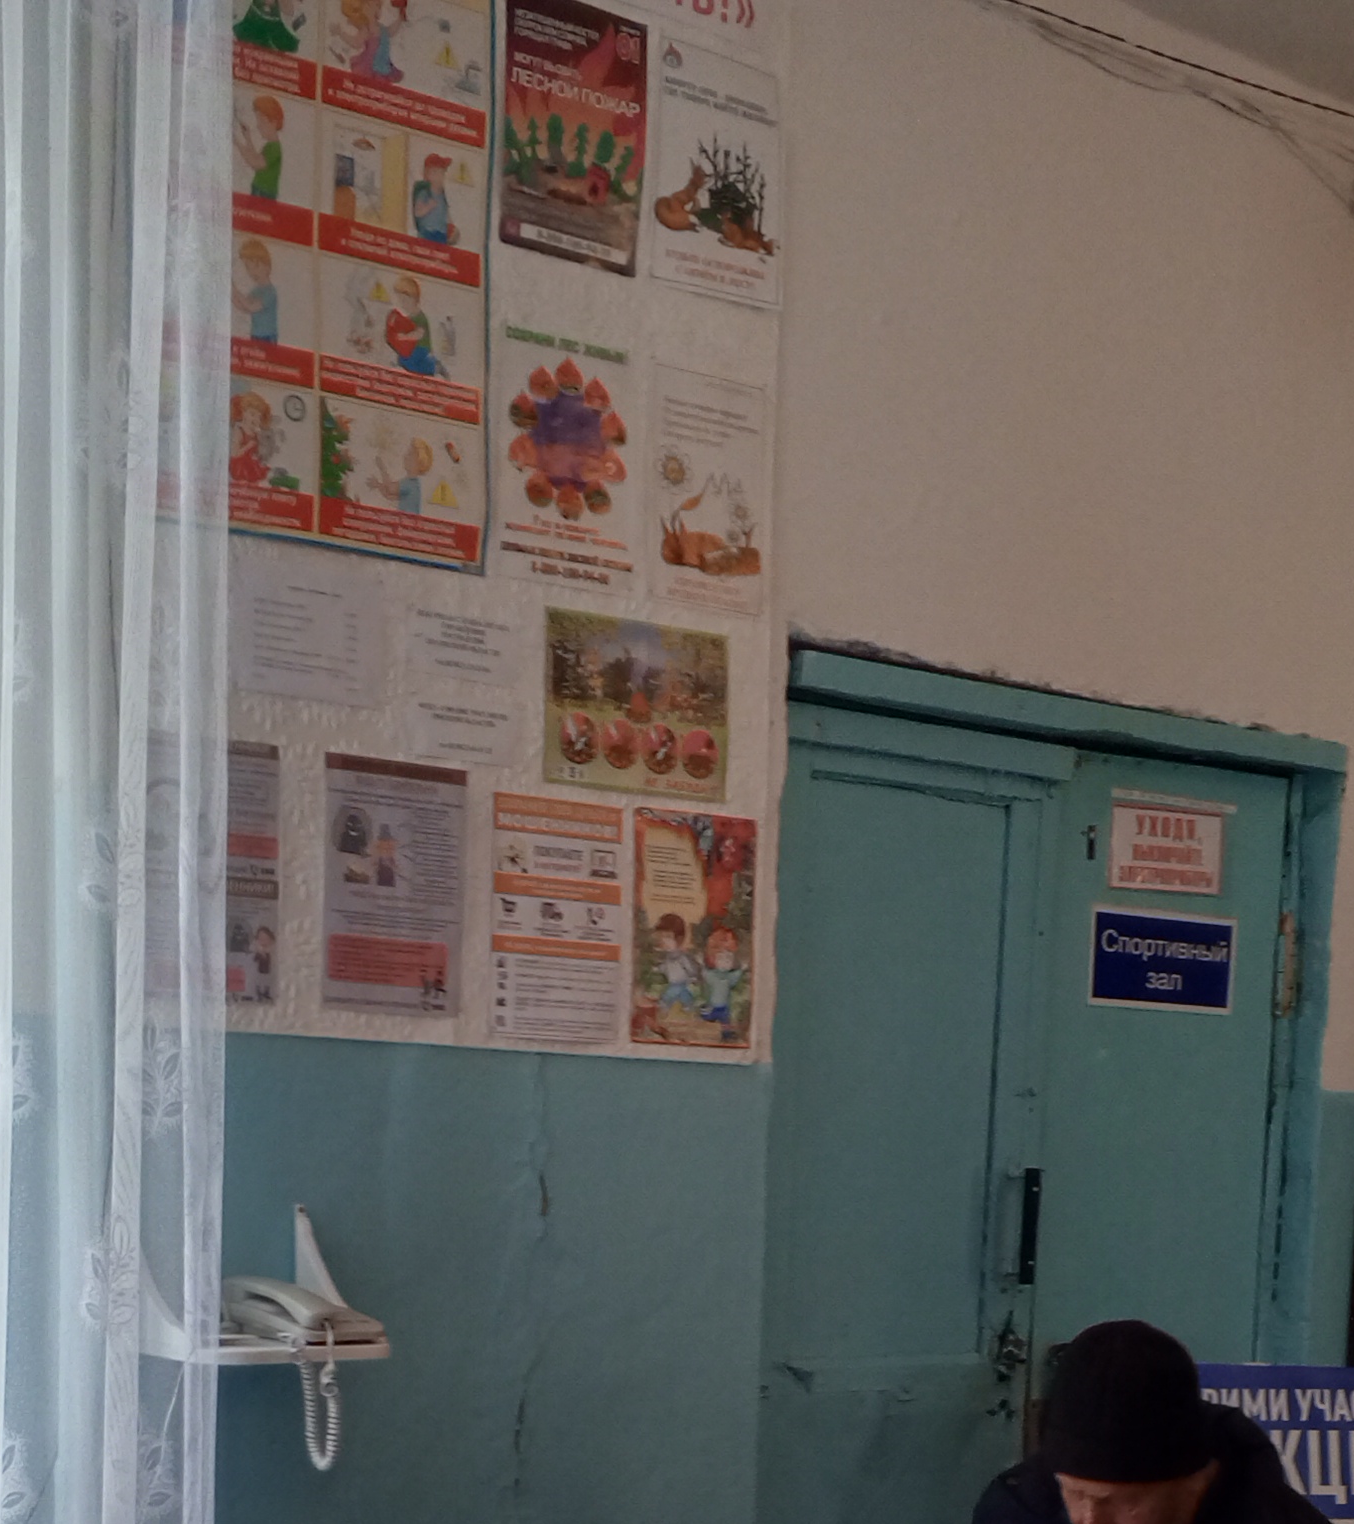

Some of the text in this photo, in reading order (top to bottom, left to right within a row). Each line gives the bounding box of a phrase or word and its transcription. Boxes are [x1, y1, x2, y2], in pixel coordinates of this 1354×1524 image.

[511, 66, 579, 100] ЛЕСНОЙ
[581, 88, 641, 117] ПОЖАР
[1101, 928, 1229, 963] Спортивный
[1145, 970, 1183, 991] зал
[1200, 1387, 1290, 1422] ИМИ
